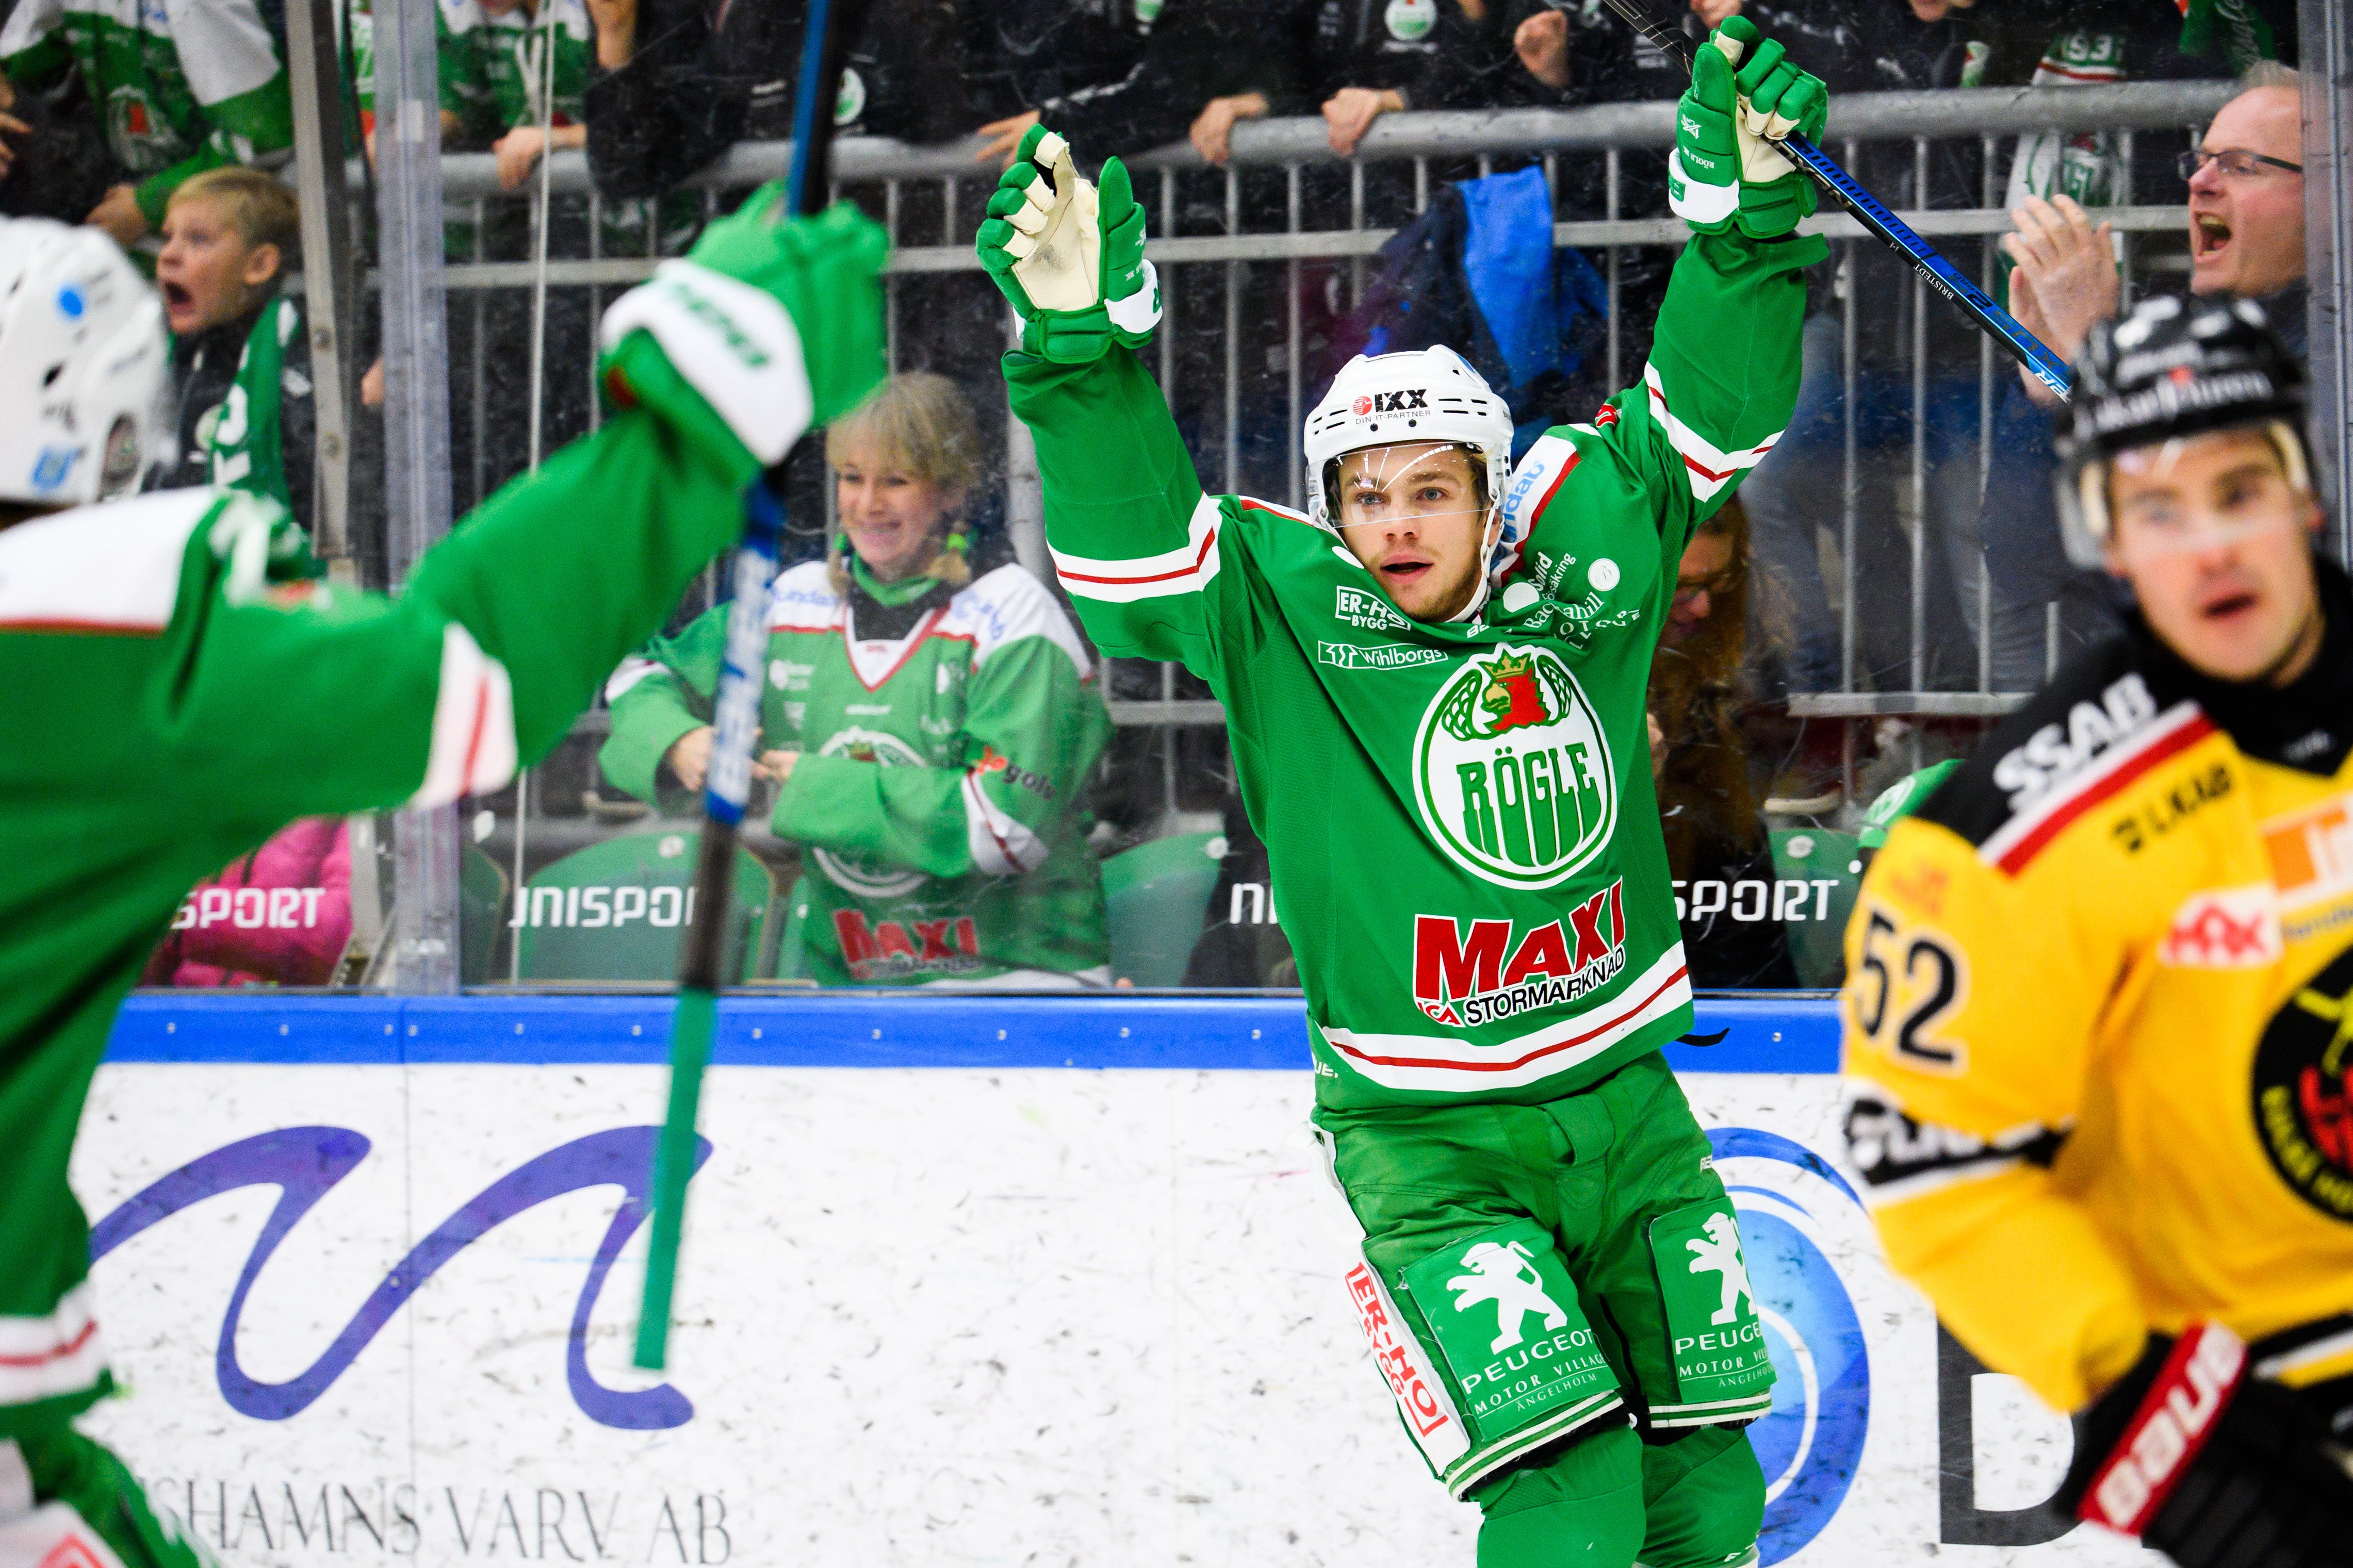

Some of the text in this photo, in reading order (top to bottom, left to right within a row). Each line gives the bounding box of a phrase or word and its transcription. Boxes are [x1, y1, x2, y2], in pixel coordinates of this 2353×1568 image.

[1914, 263, 1954, 300] BRISTEDT
[1355, 410, 1431, 424] DIN IT-PARTNER
[1374, 389, 1428, 412] IXX
[1527, 551, 1553, 592] Solid
[1351, 616, 1387, 631] BYGG
[1359, 647, 1442, 666] Wihlborgs
[1456, 741, 1602, 867] RÖGLE
[1672, 880, 1839, 921] SPORT
[1413, 875, 1626, 1003] MAXI
[1464, 944, 1625, 1027] STORMARKNAD
[1856, 909, 1956, 1067] 52
[1352, 1275, 1437, 1418] ER-HO
[1363, 1316, 1405, 1395] BYGG
[1675, 1321, 1762, 1355] PEUGE
[1461, 1328, 1593, 1395] PEUGEOT
[1679, 1357, 1743, 1378] MOTOR
[1474, 1374, 1542, 1415] MOTOR
[1516, 1373, 1597, 1412] ÄNGELHOLM
[445, 1483, 620, 1562] VARV
[647, 1490, 733, 1565] AB
